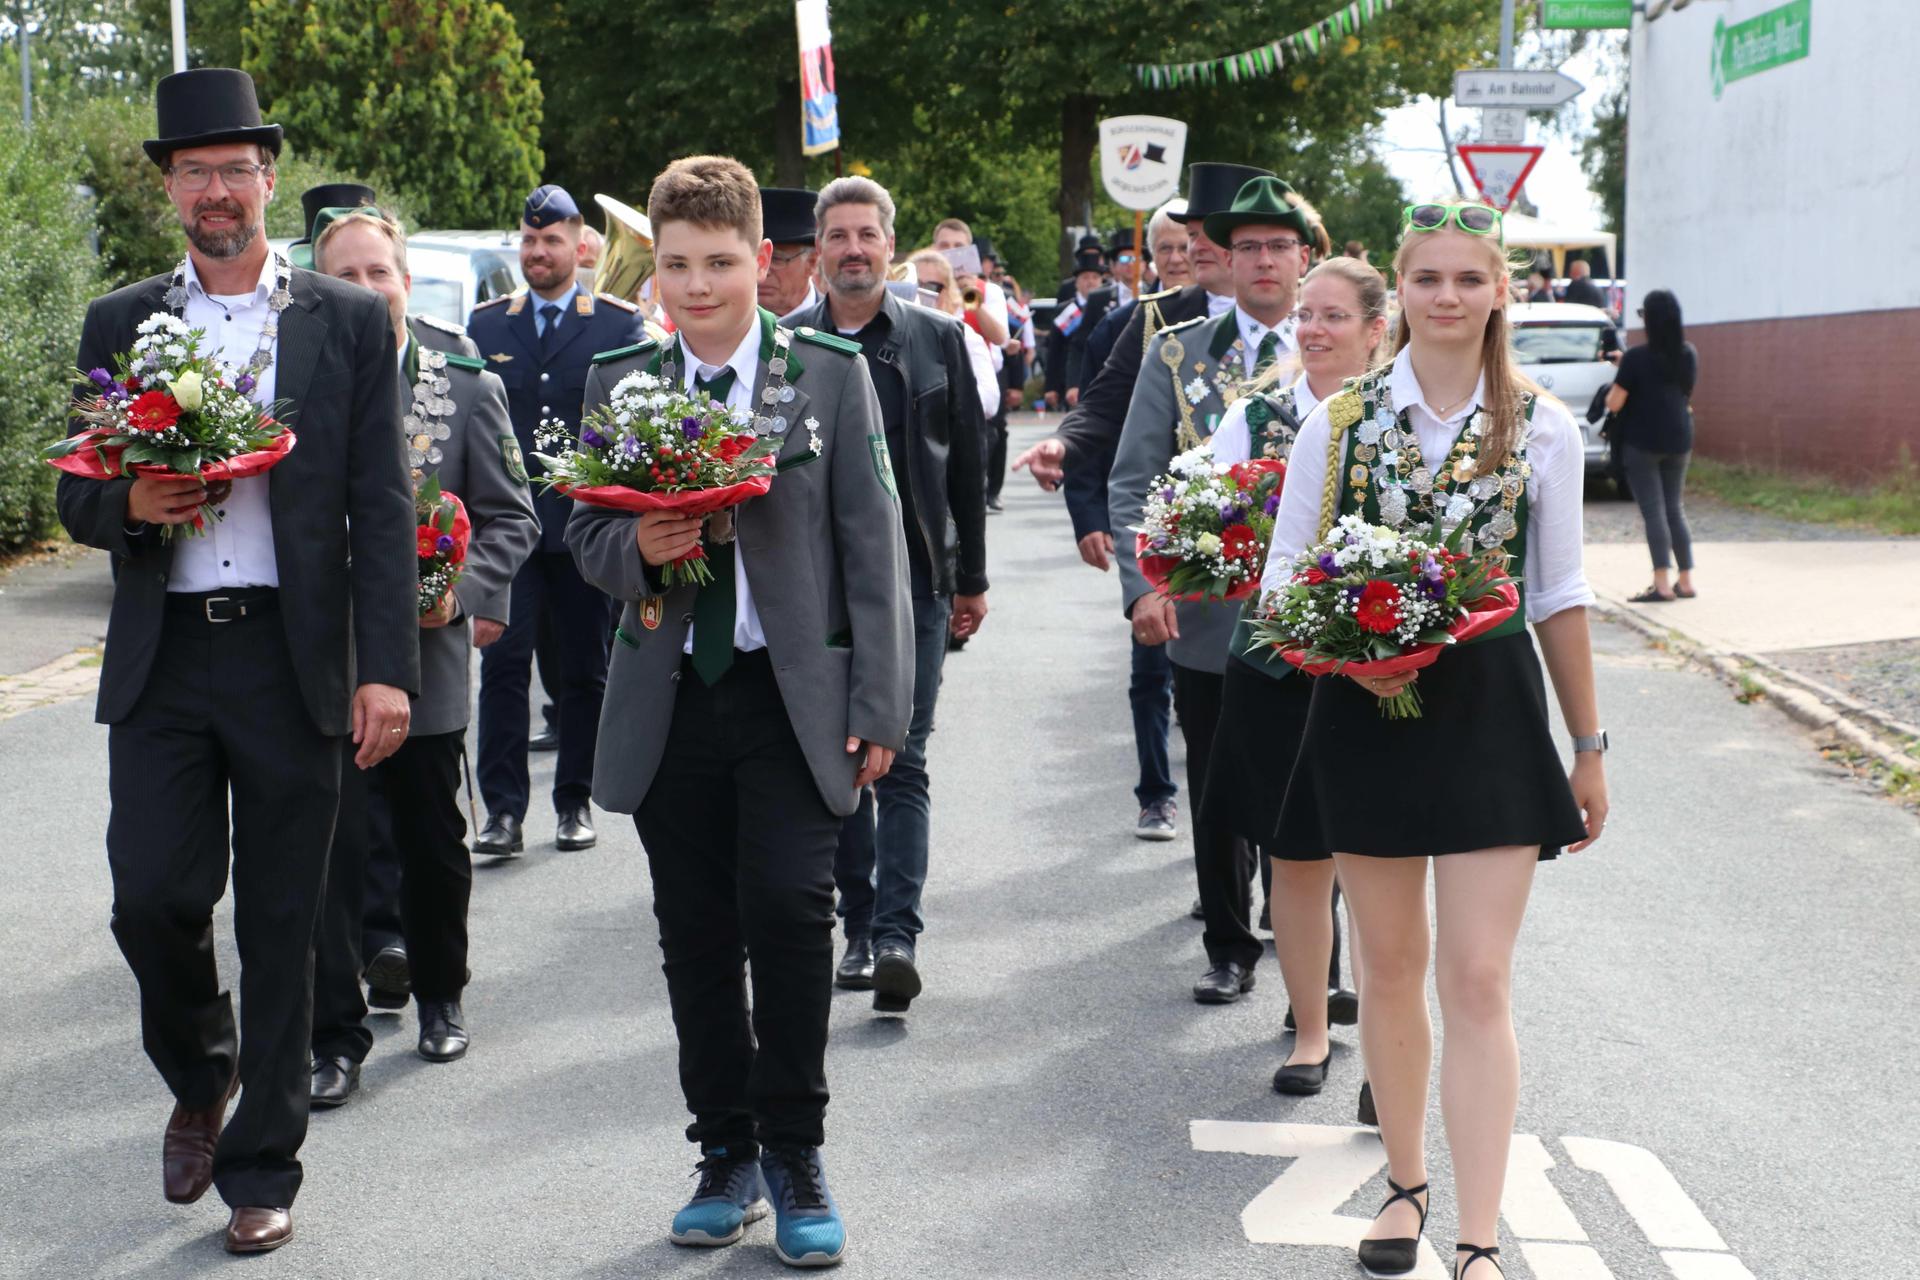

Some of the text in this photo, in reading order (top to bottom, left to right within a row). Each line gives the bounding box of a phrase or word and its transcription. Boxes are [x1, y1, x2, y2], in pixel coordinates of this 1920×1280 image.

[1549, 4, 1630, 20] Raiffeisen
[1489, 82, 1556, 96] Am Bahnhof
